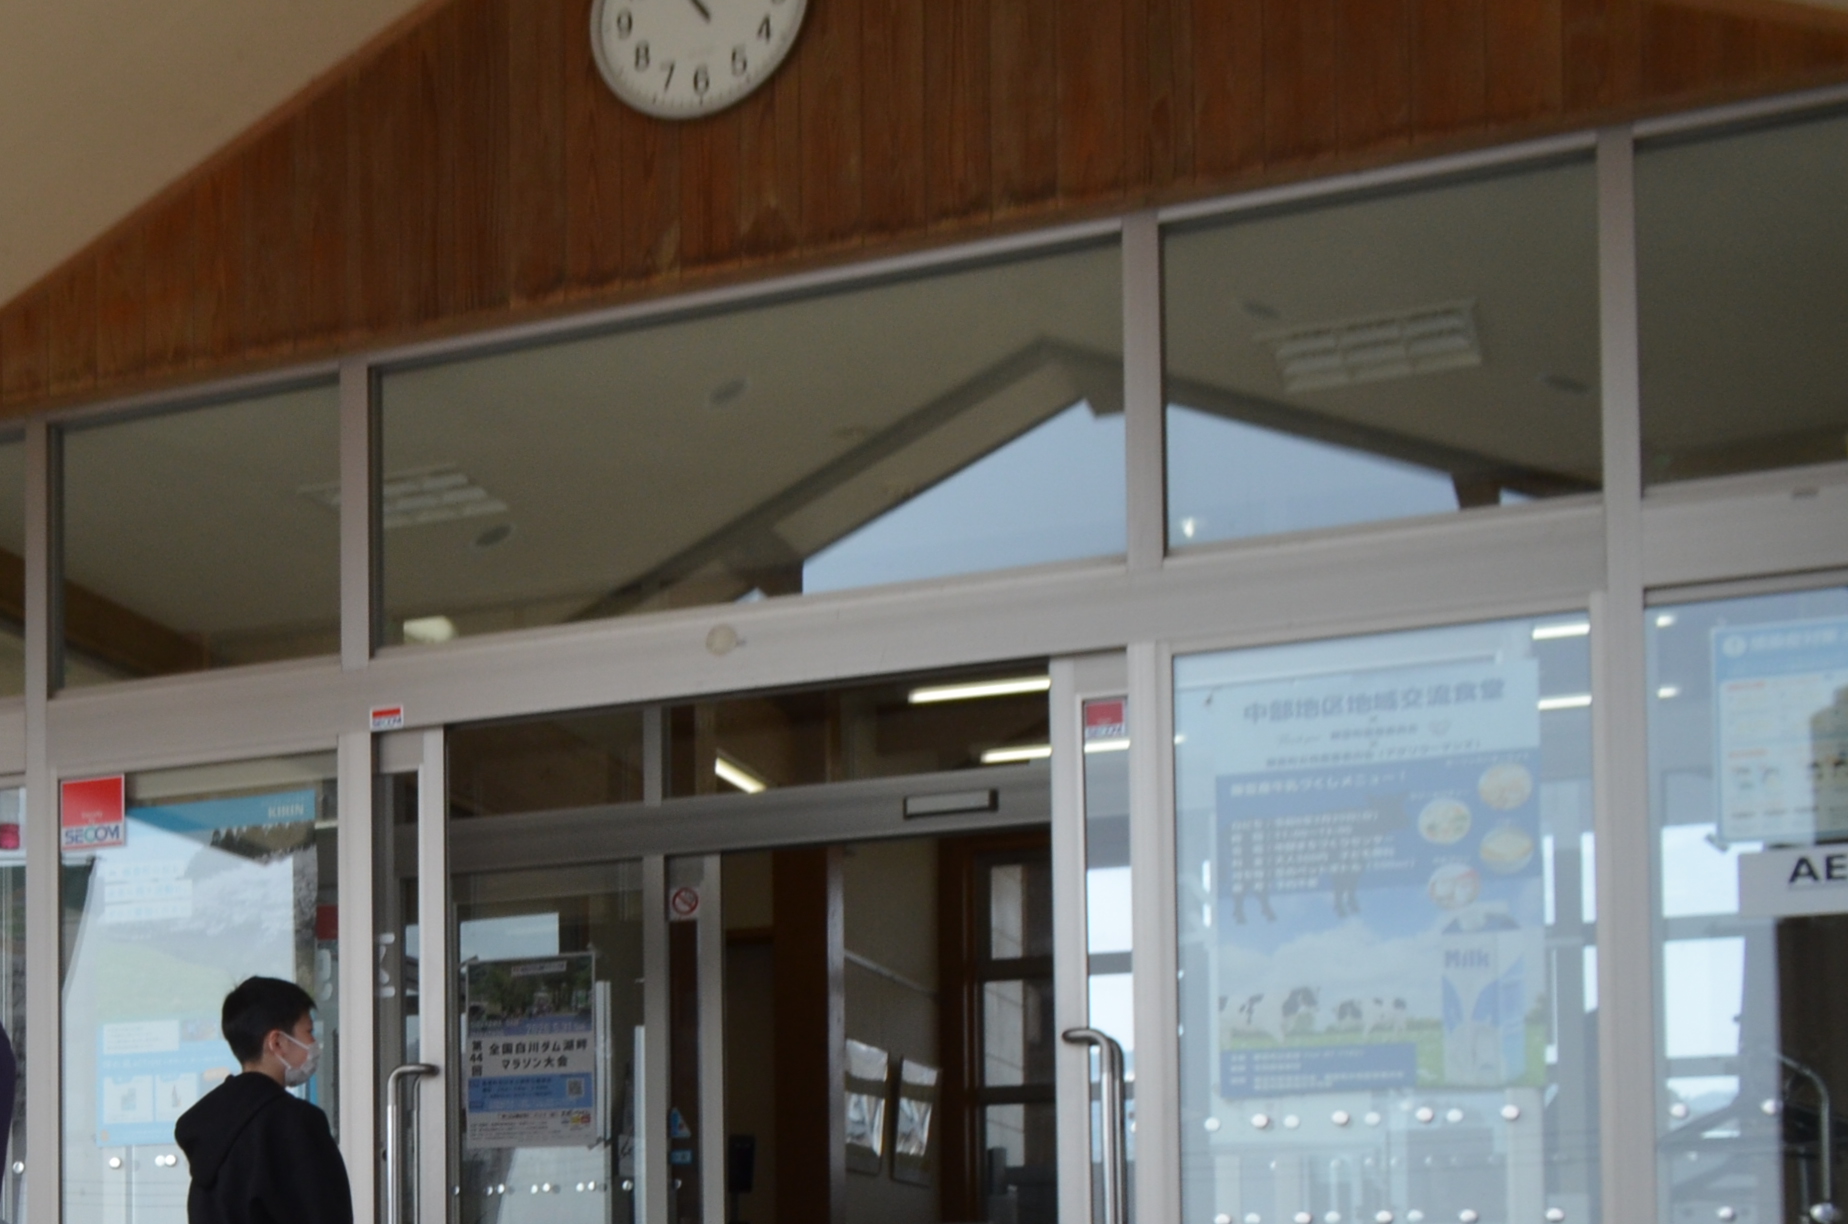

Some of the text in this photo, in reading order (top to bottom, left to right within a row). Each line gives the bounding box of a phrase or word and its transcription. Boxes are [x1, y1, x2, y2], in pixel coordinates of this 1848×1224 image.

[660, 61, 675, 92] 7
[267, 803, 305, 818] KIRIN
[65, 825, 120, 845] SECOM
[1444, 949, 1490, 968] Milk
[502, 1055, 568, 1070] マラソン大会
